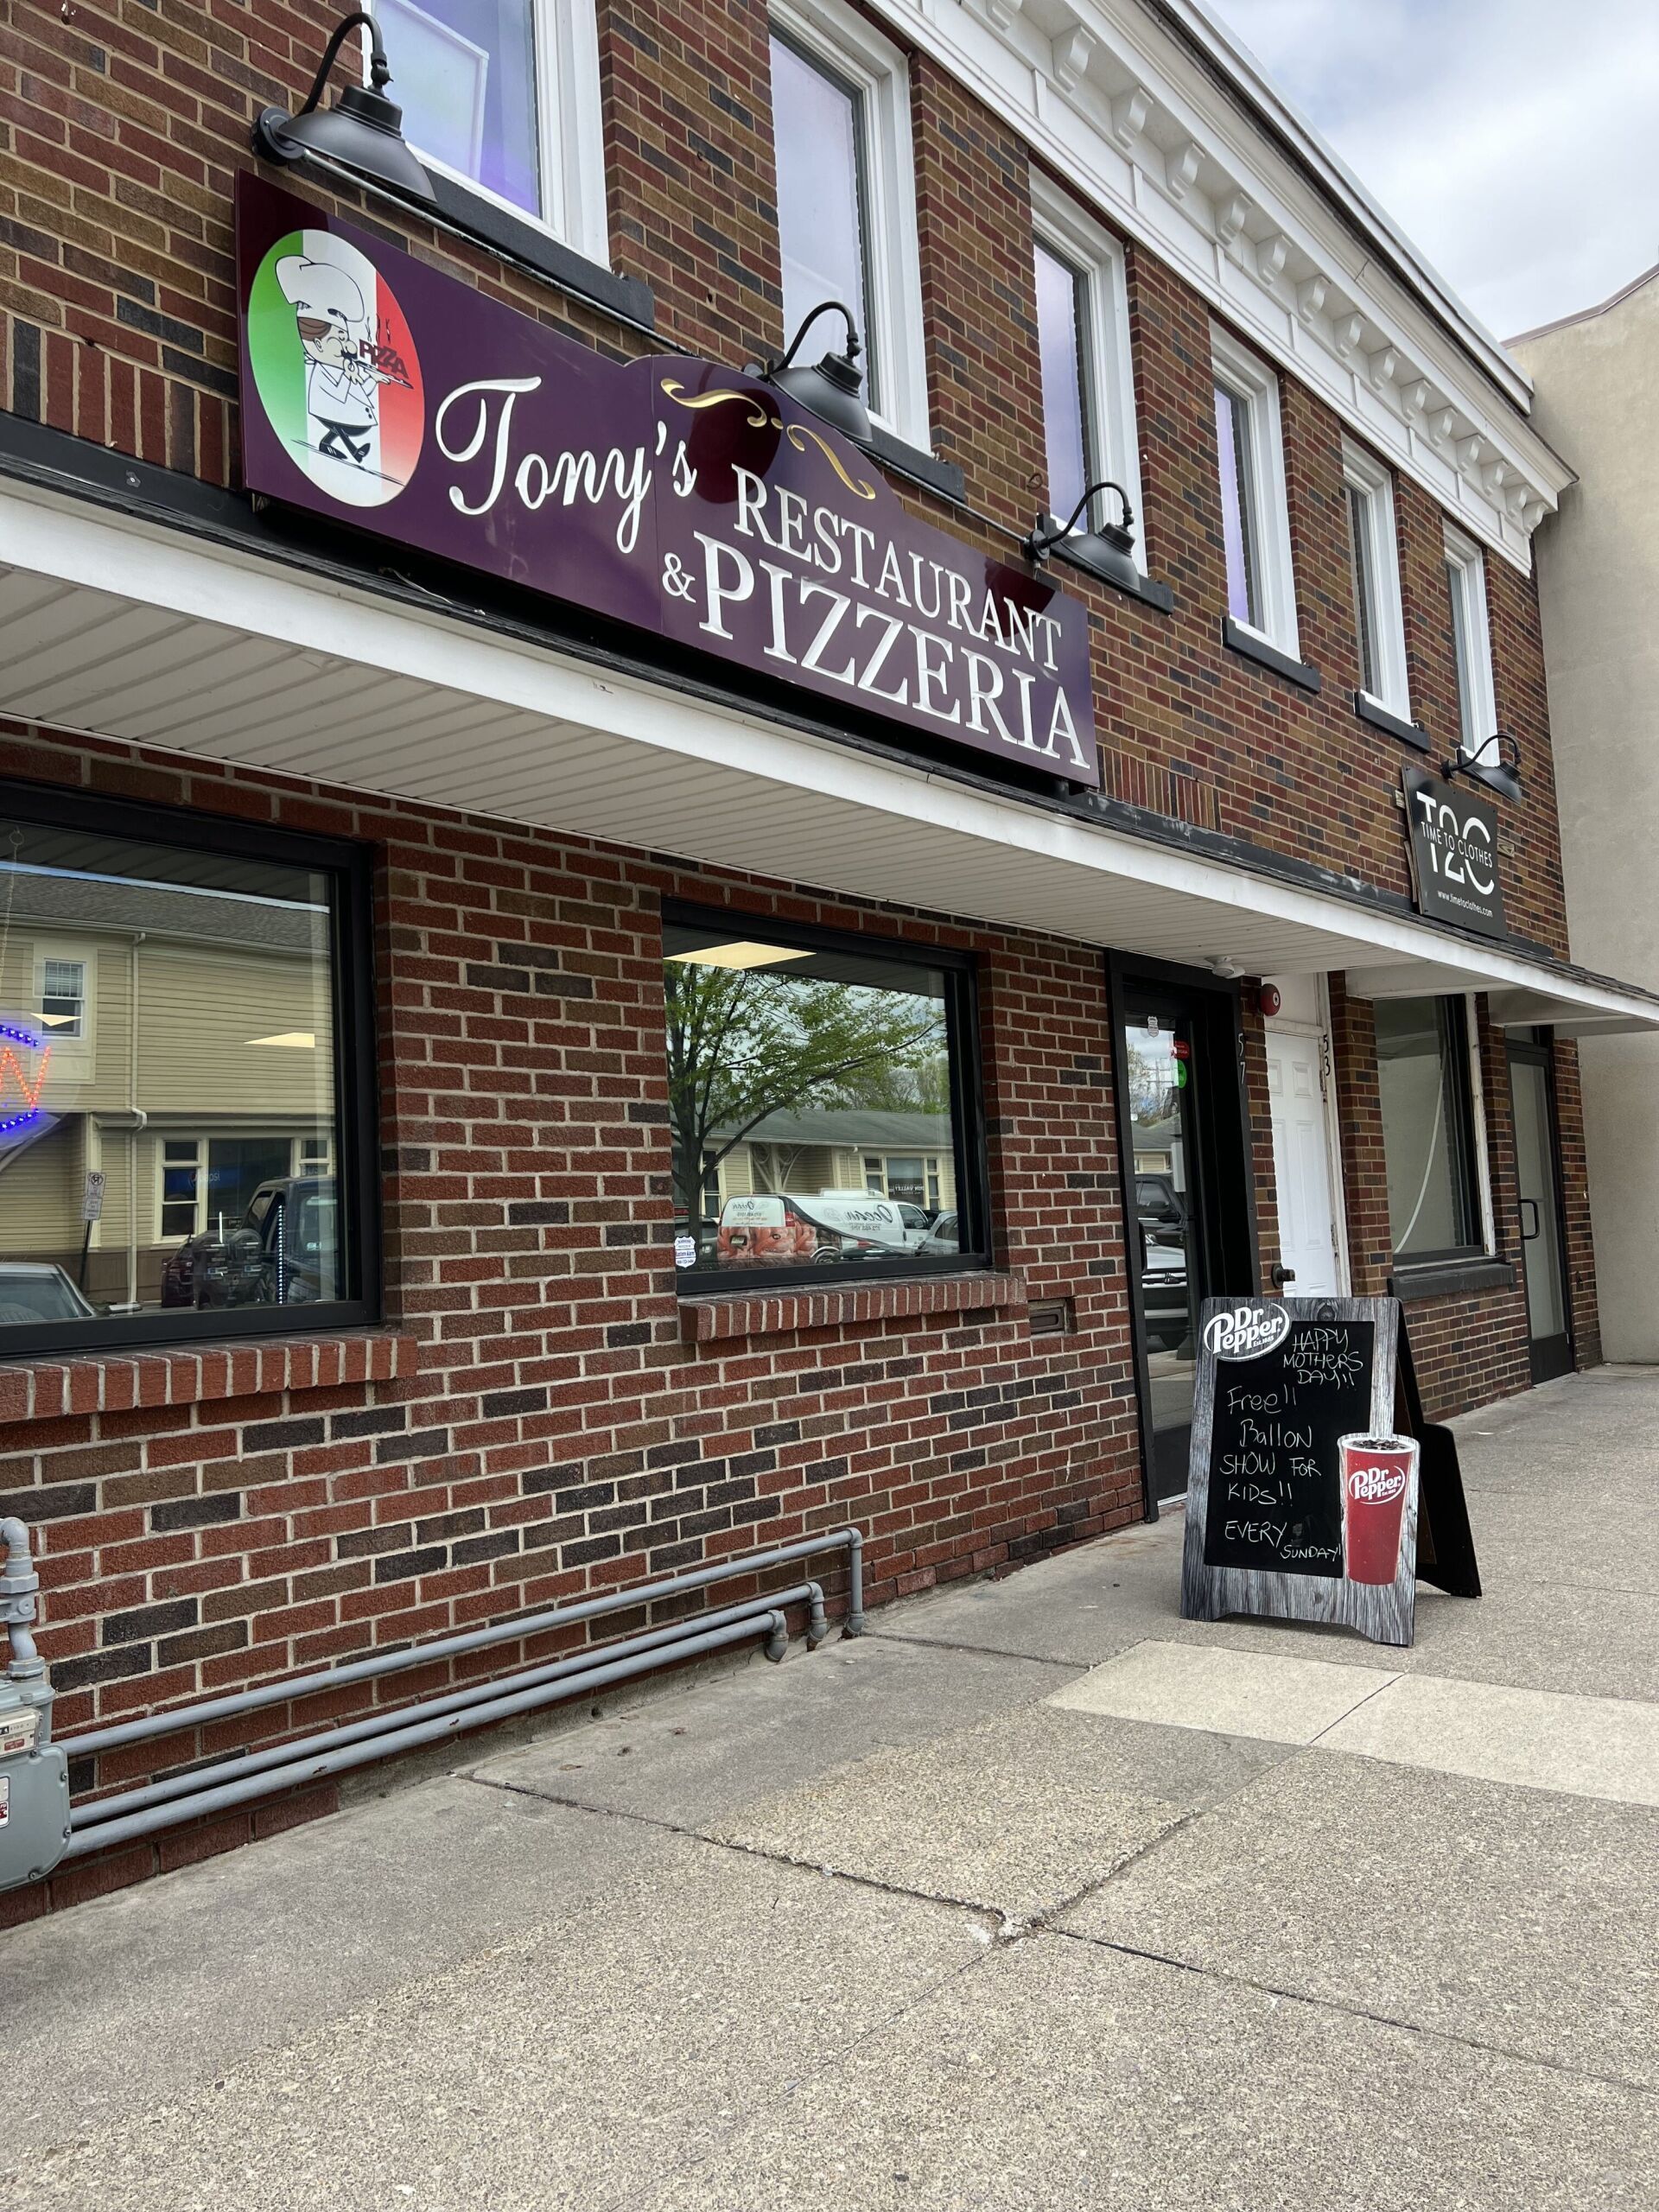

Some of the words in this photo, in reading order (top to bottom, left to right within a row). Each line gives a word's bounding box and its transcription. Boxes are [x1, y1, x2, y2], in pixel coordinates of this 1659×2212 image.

[359, 339, 409, 378] PIZZA
[435, 376, 697, 554] Tony's
[731, 463, 1062, 671] RESTAURANT
[662, 551, 696, 604] &
[693, 531, 1090, 770] PIZZERIA
[1421, 821, 1442, 845] TIME
[1444, 832, 1455, 851] TO
[1458, 839, 1493, 868] CLOTHES
[1234, 1307, 1264, 1332] Dr
[1292, 1327, 1348, 1353] HAPPY
[1219, 1452, 1275, 1475] SHOW
[1368, 1467, 1389, 1484] Dr
[1225, 1520, 1287, 1548] EVERY
